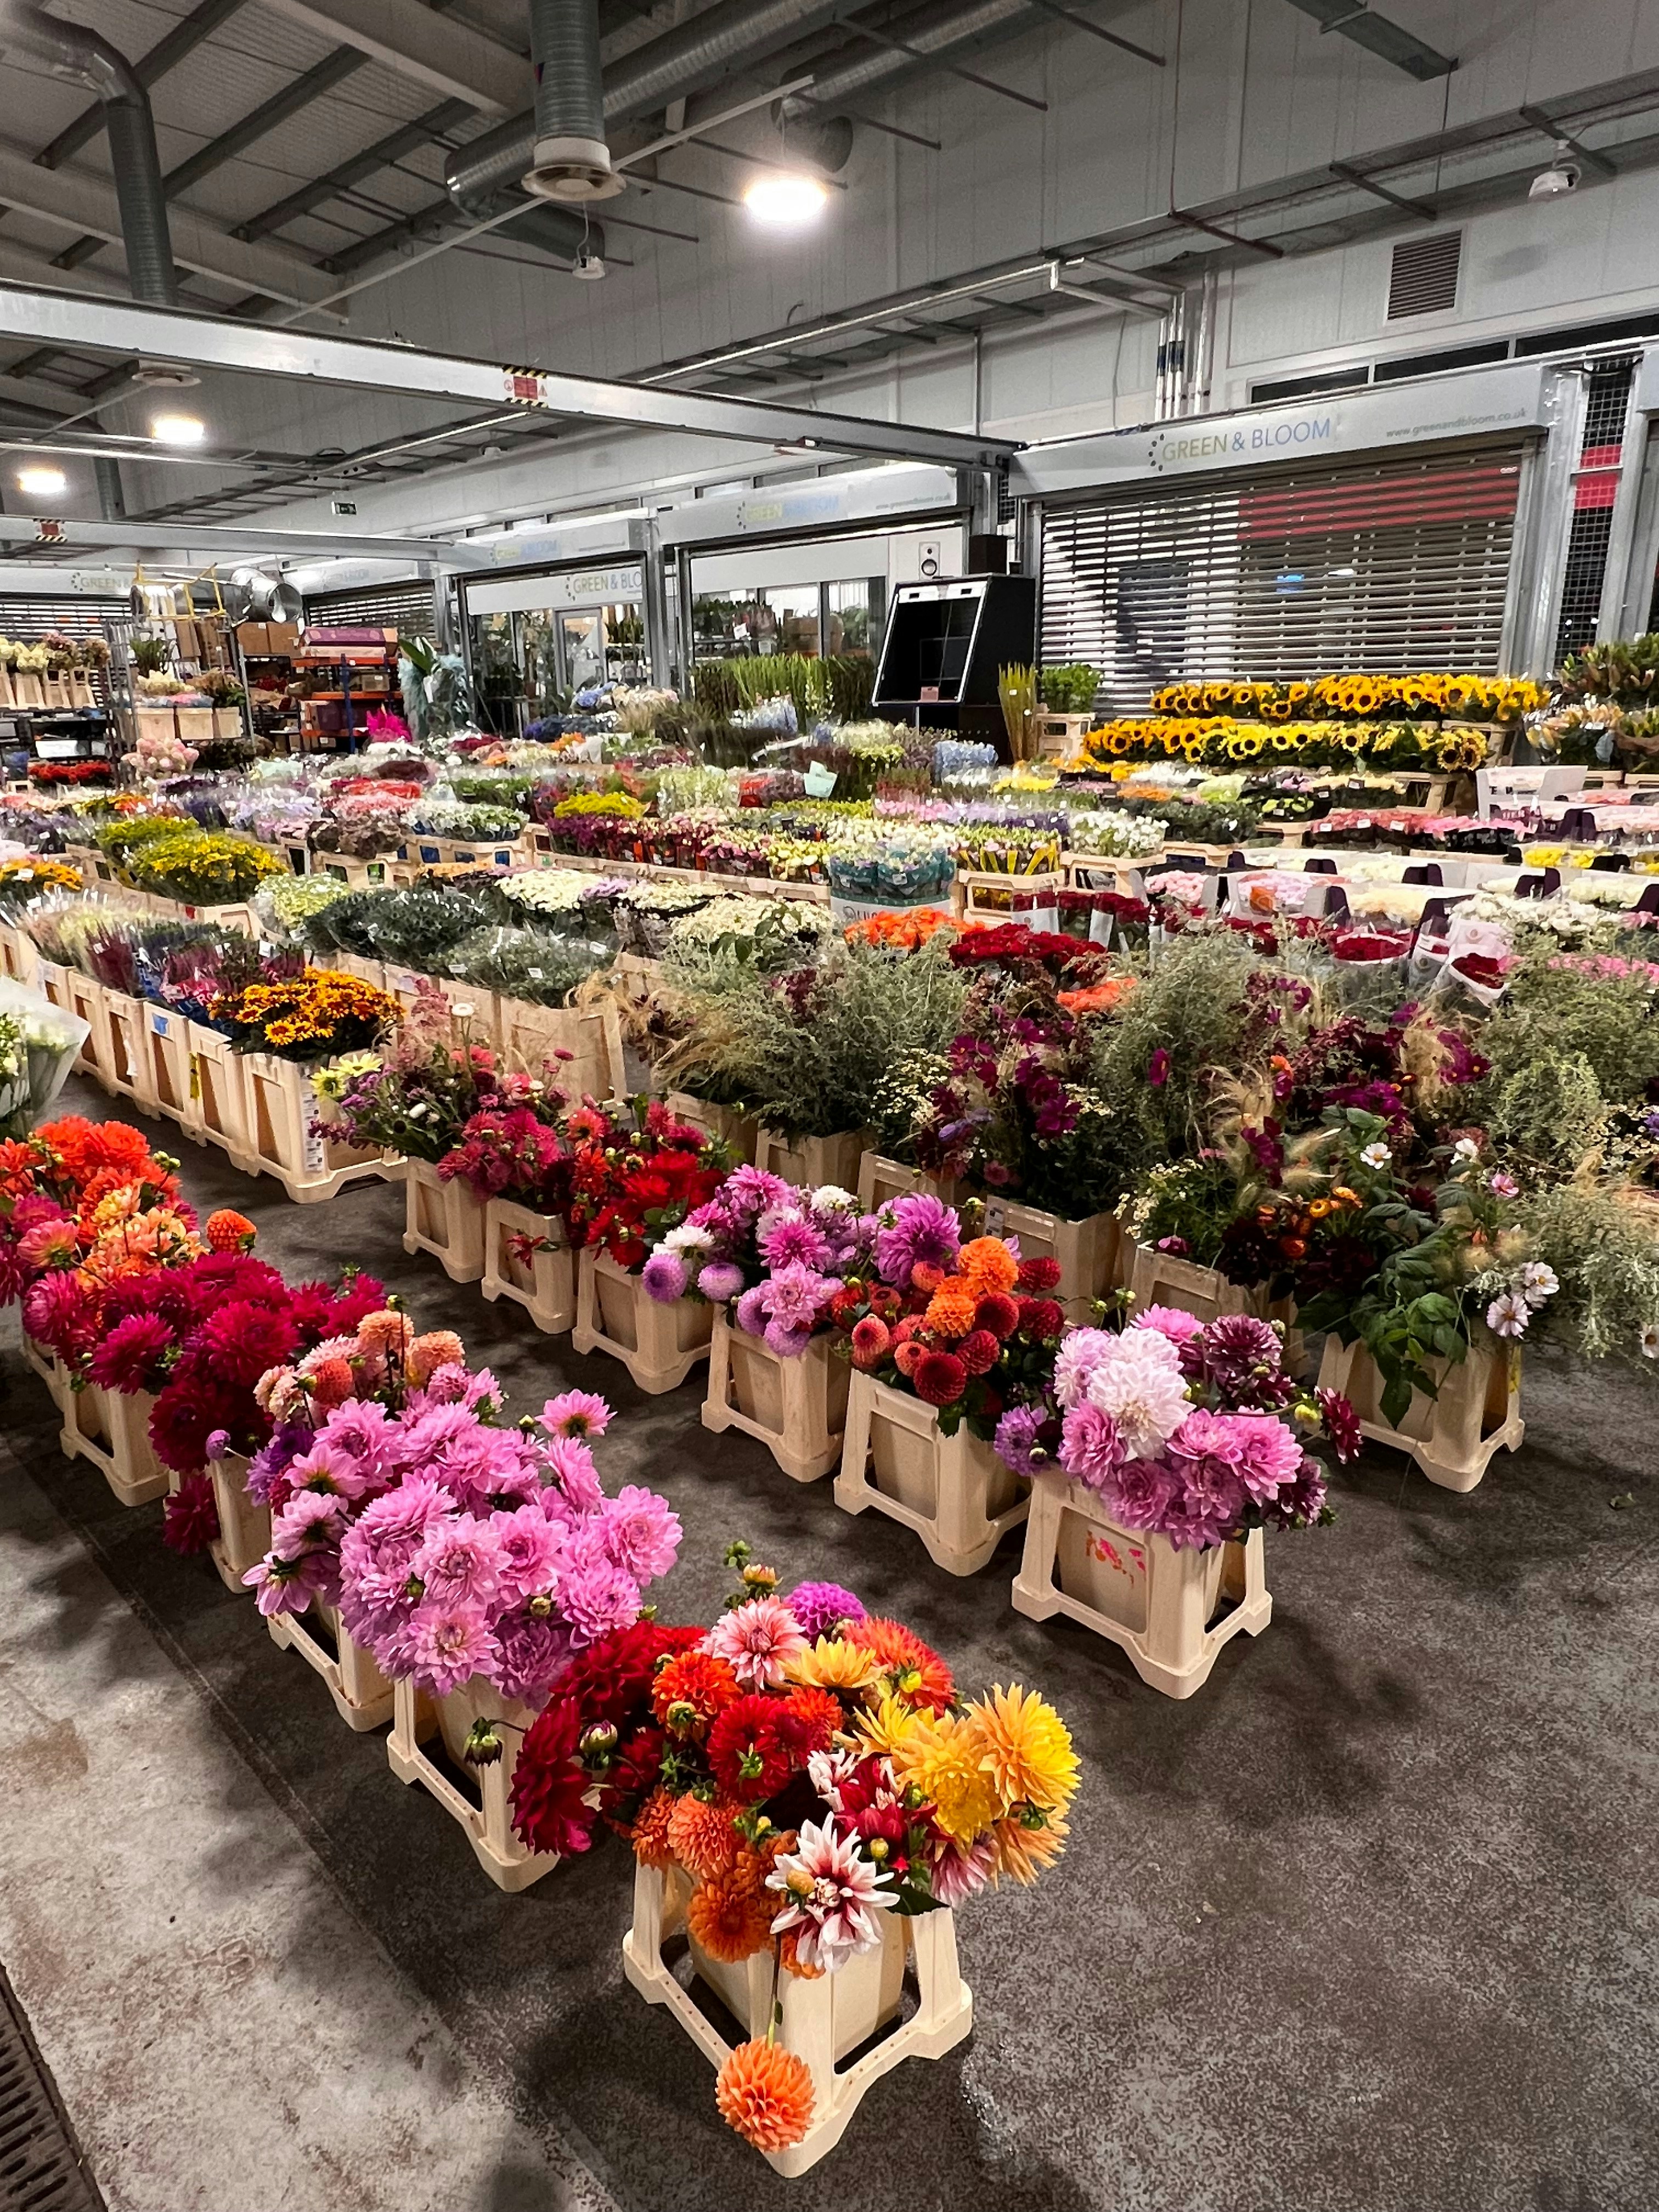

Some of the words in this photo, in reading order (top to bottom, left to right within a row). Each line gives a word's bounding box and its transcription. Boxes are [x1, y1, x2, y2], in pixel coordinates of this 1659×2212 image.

[1162, 434, 1228, 462] GREEN
[1232, 432, 1245, 452] &
[1251, 418, 1330, 449] BLOOM
[573, 575, 608, 594] GREEN
[610, 574, 618, 589] &
